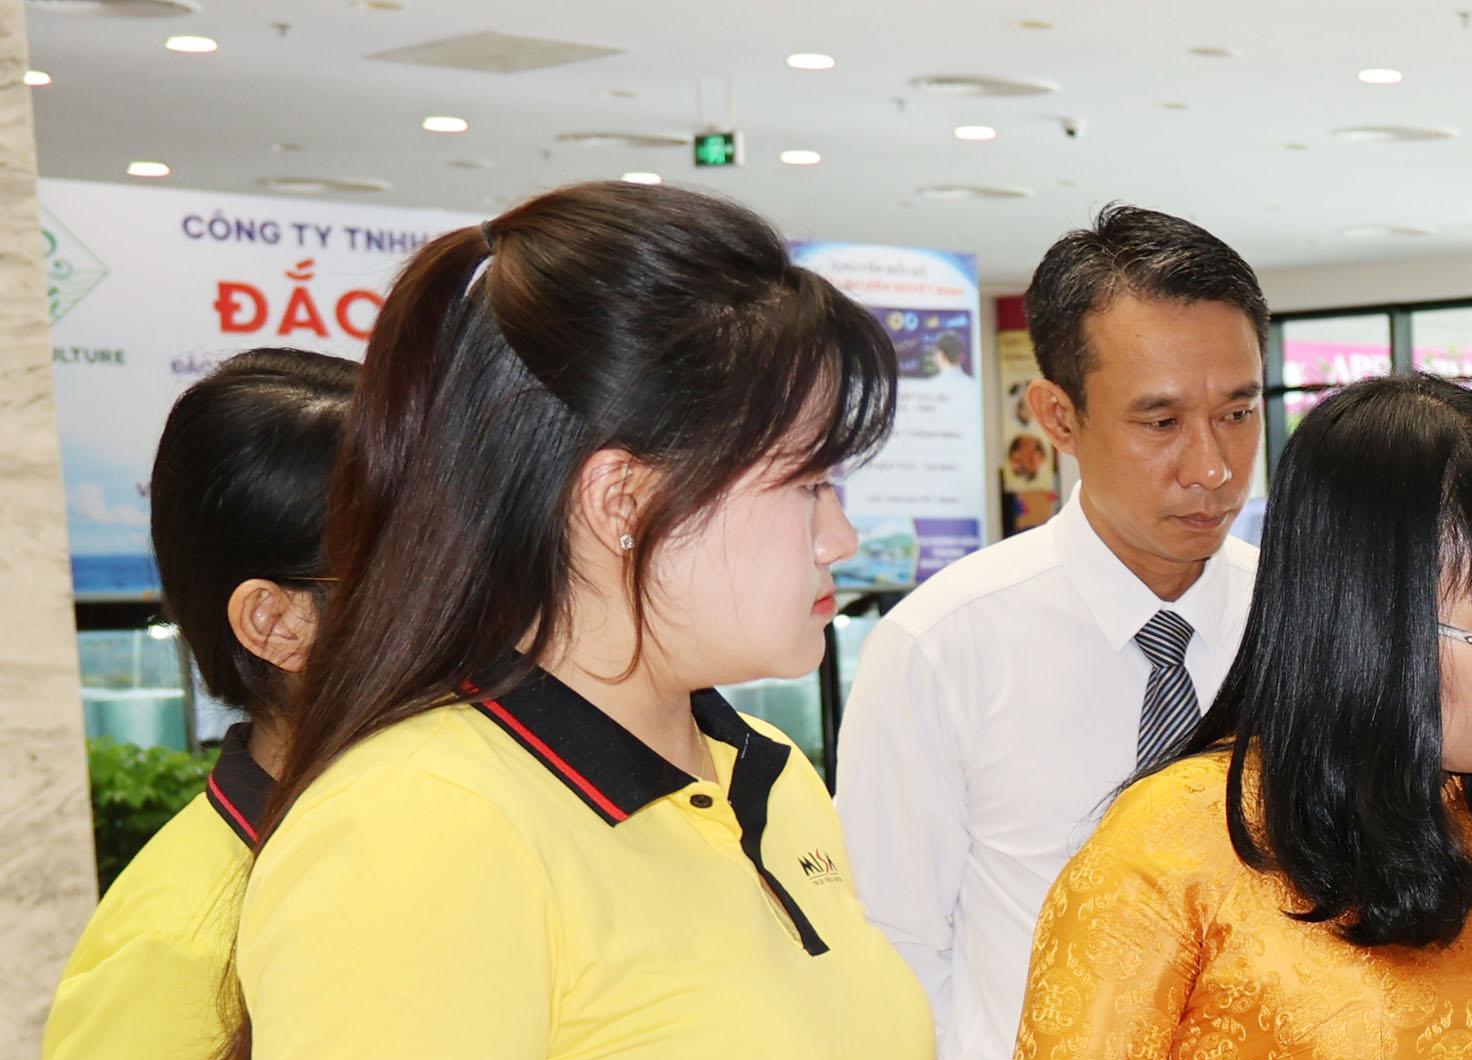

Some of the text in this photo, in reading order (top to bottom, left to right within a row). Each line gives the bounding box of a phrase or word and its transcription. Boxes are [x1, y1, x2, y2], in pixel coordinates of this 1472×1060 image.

[182, 209, 428, 252] CÔNG TY TNHH
